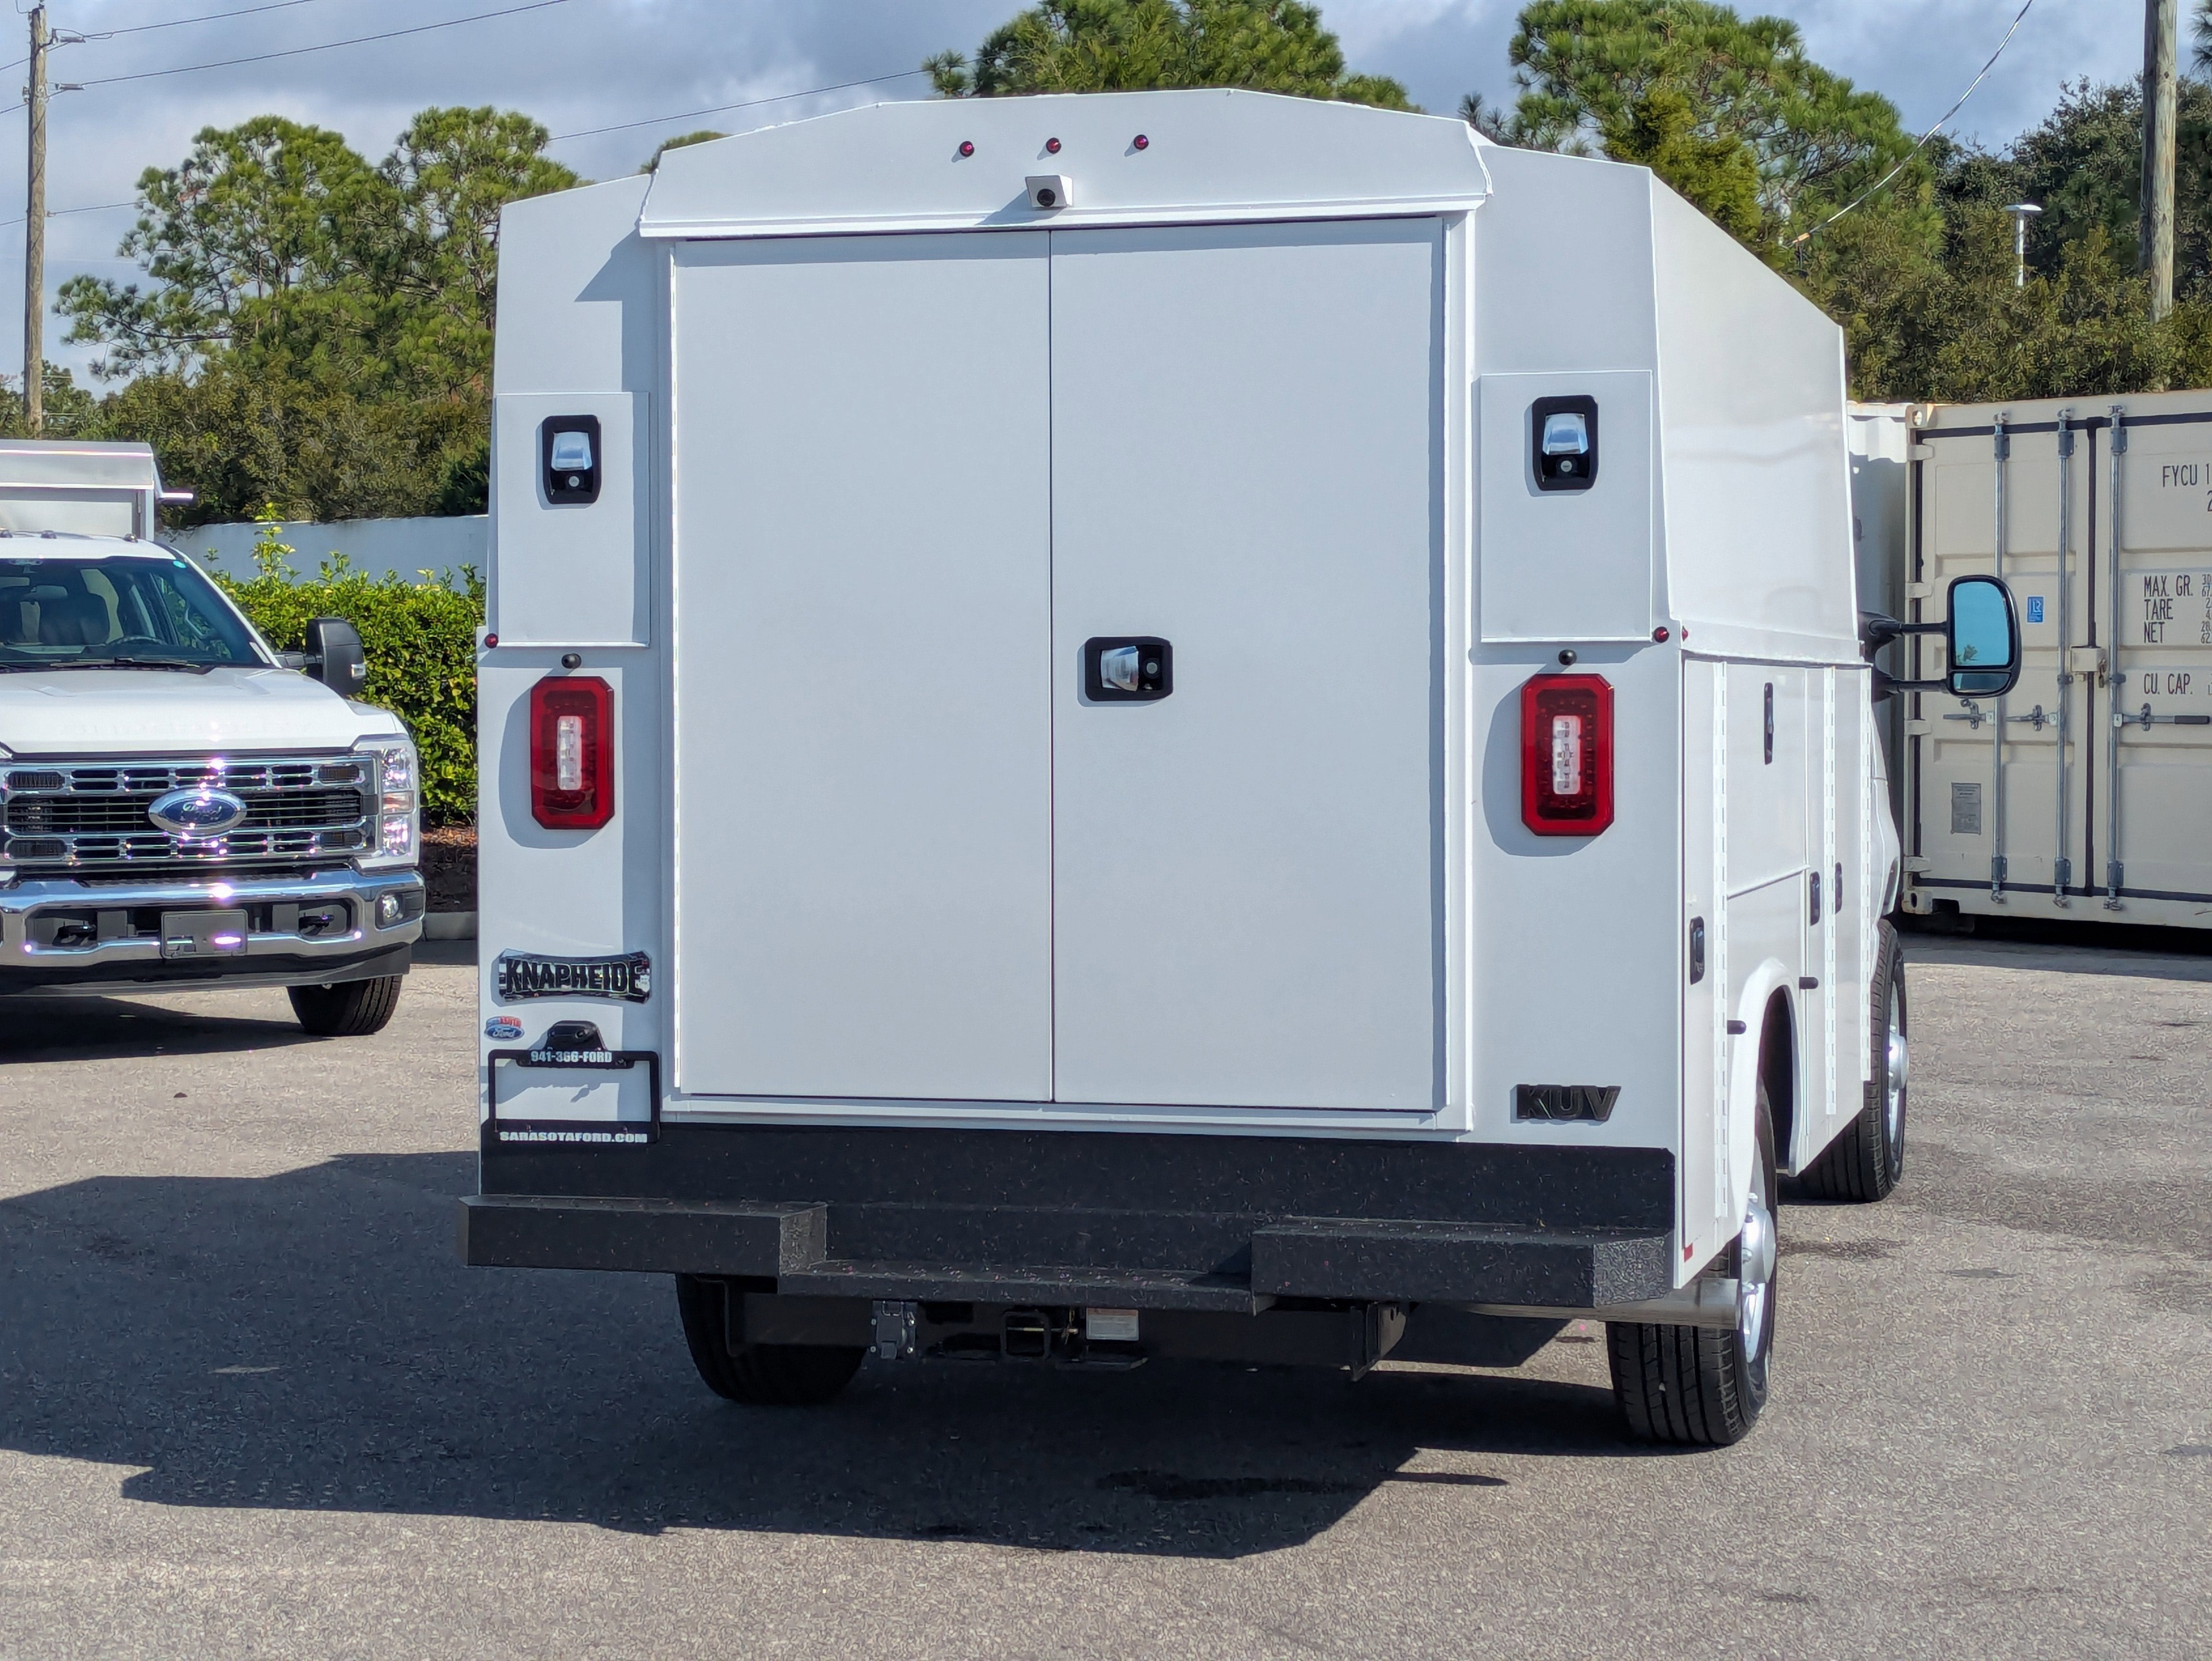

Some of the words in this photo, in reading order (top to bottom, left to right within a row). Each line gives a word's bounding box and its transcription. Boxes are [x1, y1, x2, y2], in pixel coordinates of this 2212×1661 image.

[2162, 464, 2198, 487] FYCU
[2144, 575, 2169, 597] MAX.
[2176, 575, 2193, 597] GR.
[2144, 598, 2173, 620] TARE
[2144, 621, 2165, 643] NET
[2144, 673, 2160, 695] CU.
[2168, 673, 2193, 695] CAP.
[506, 957, 645, 997] KNAPHEIDE
[1516, 1084, 1622, 1121] KUV
[499, 1131, 648, 1143] SARASOTAFORD.COM
